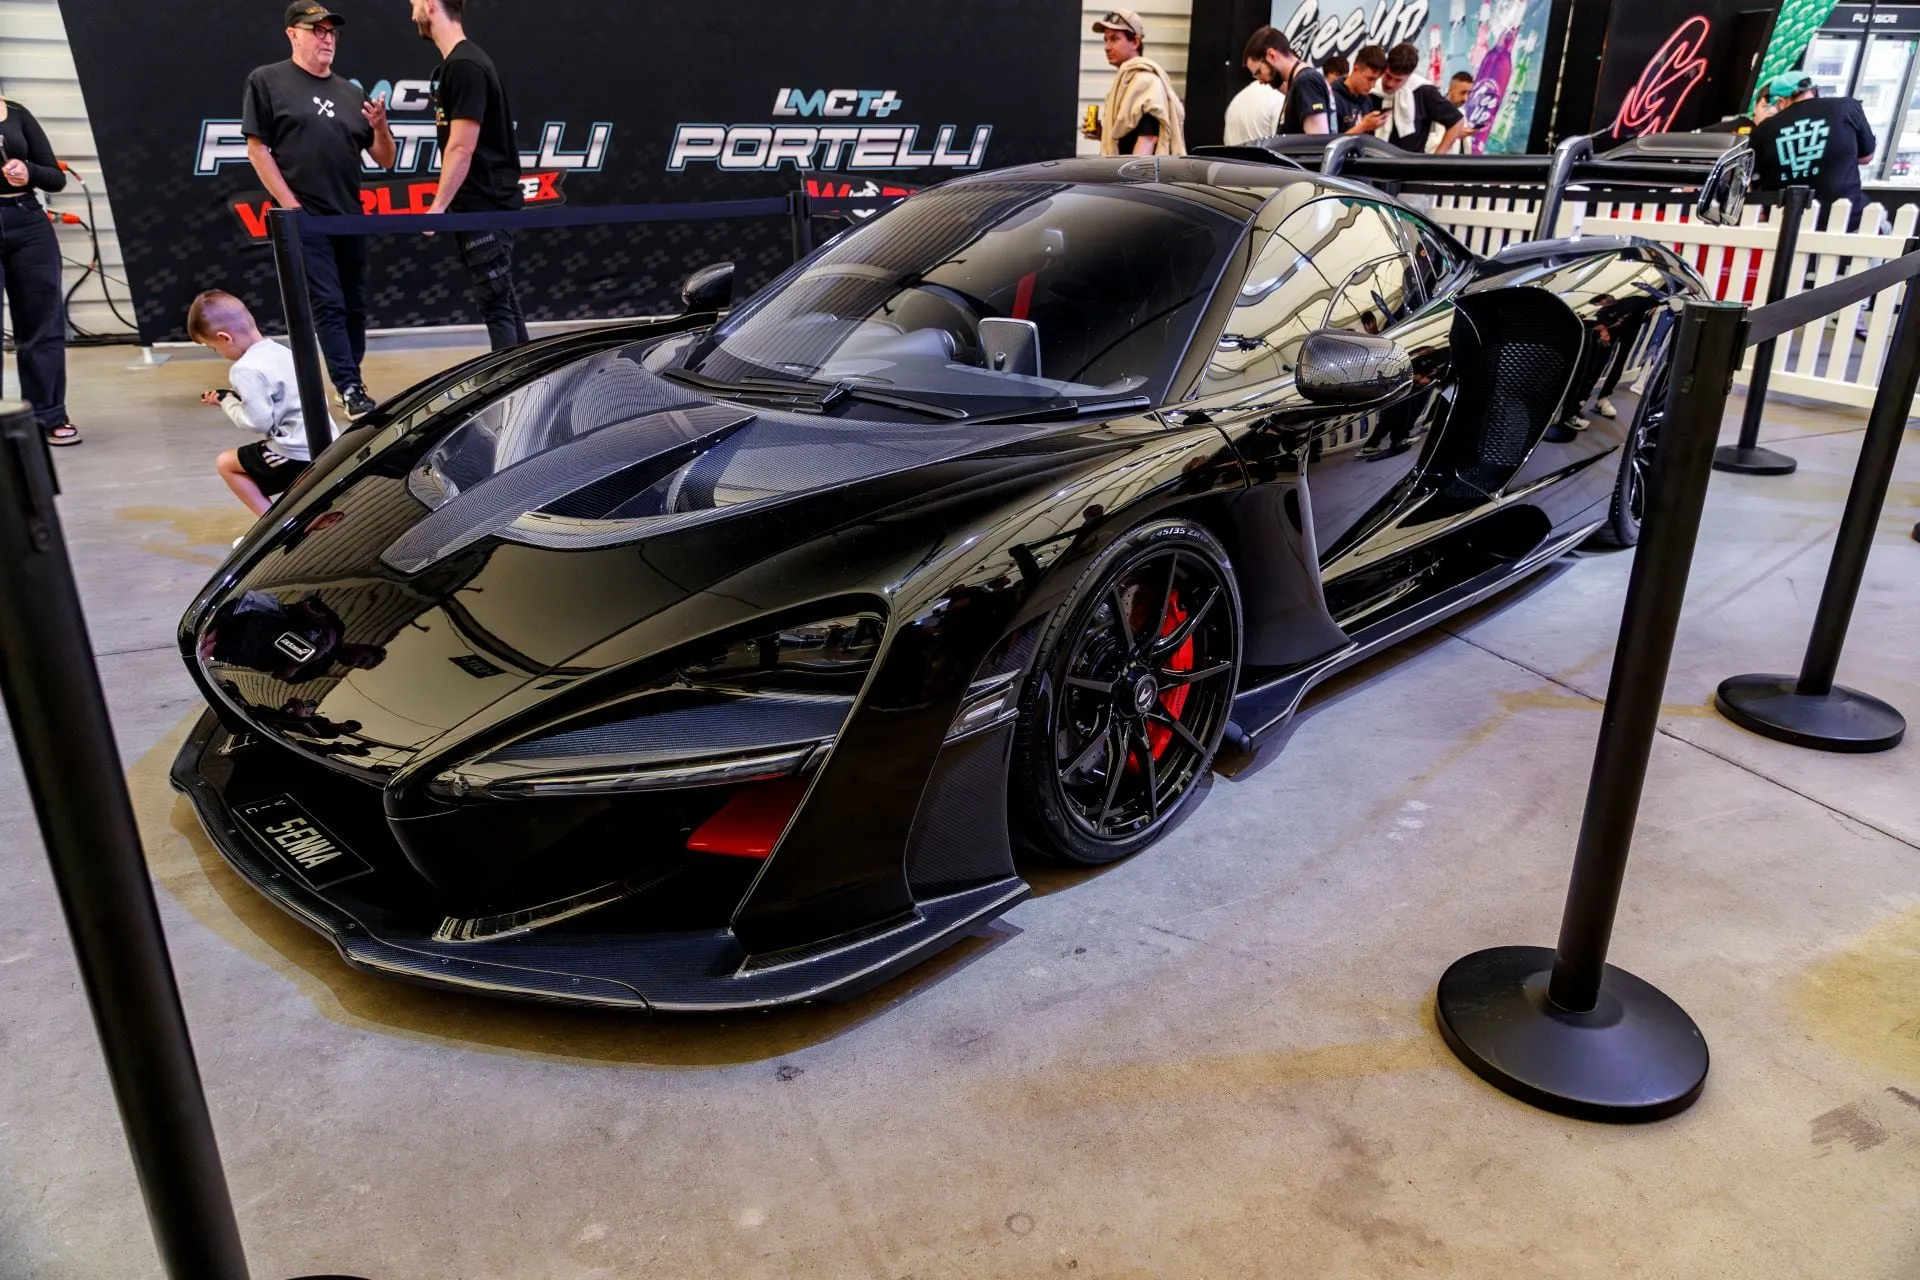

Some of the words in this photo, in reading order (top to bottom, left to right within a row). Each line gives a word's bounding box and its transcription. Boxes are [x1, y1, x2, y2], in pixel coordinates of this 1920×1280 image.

[1852, 13, 1898, 23] FLISIDE
[772, 88, 902, 117] LMCT+
[665, 123, 993, 171] PORTELLI
[245, 800, 286, 814] VIC
